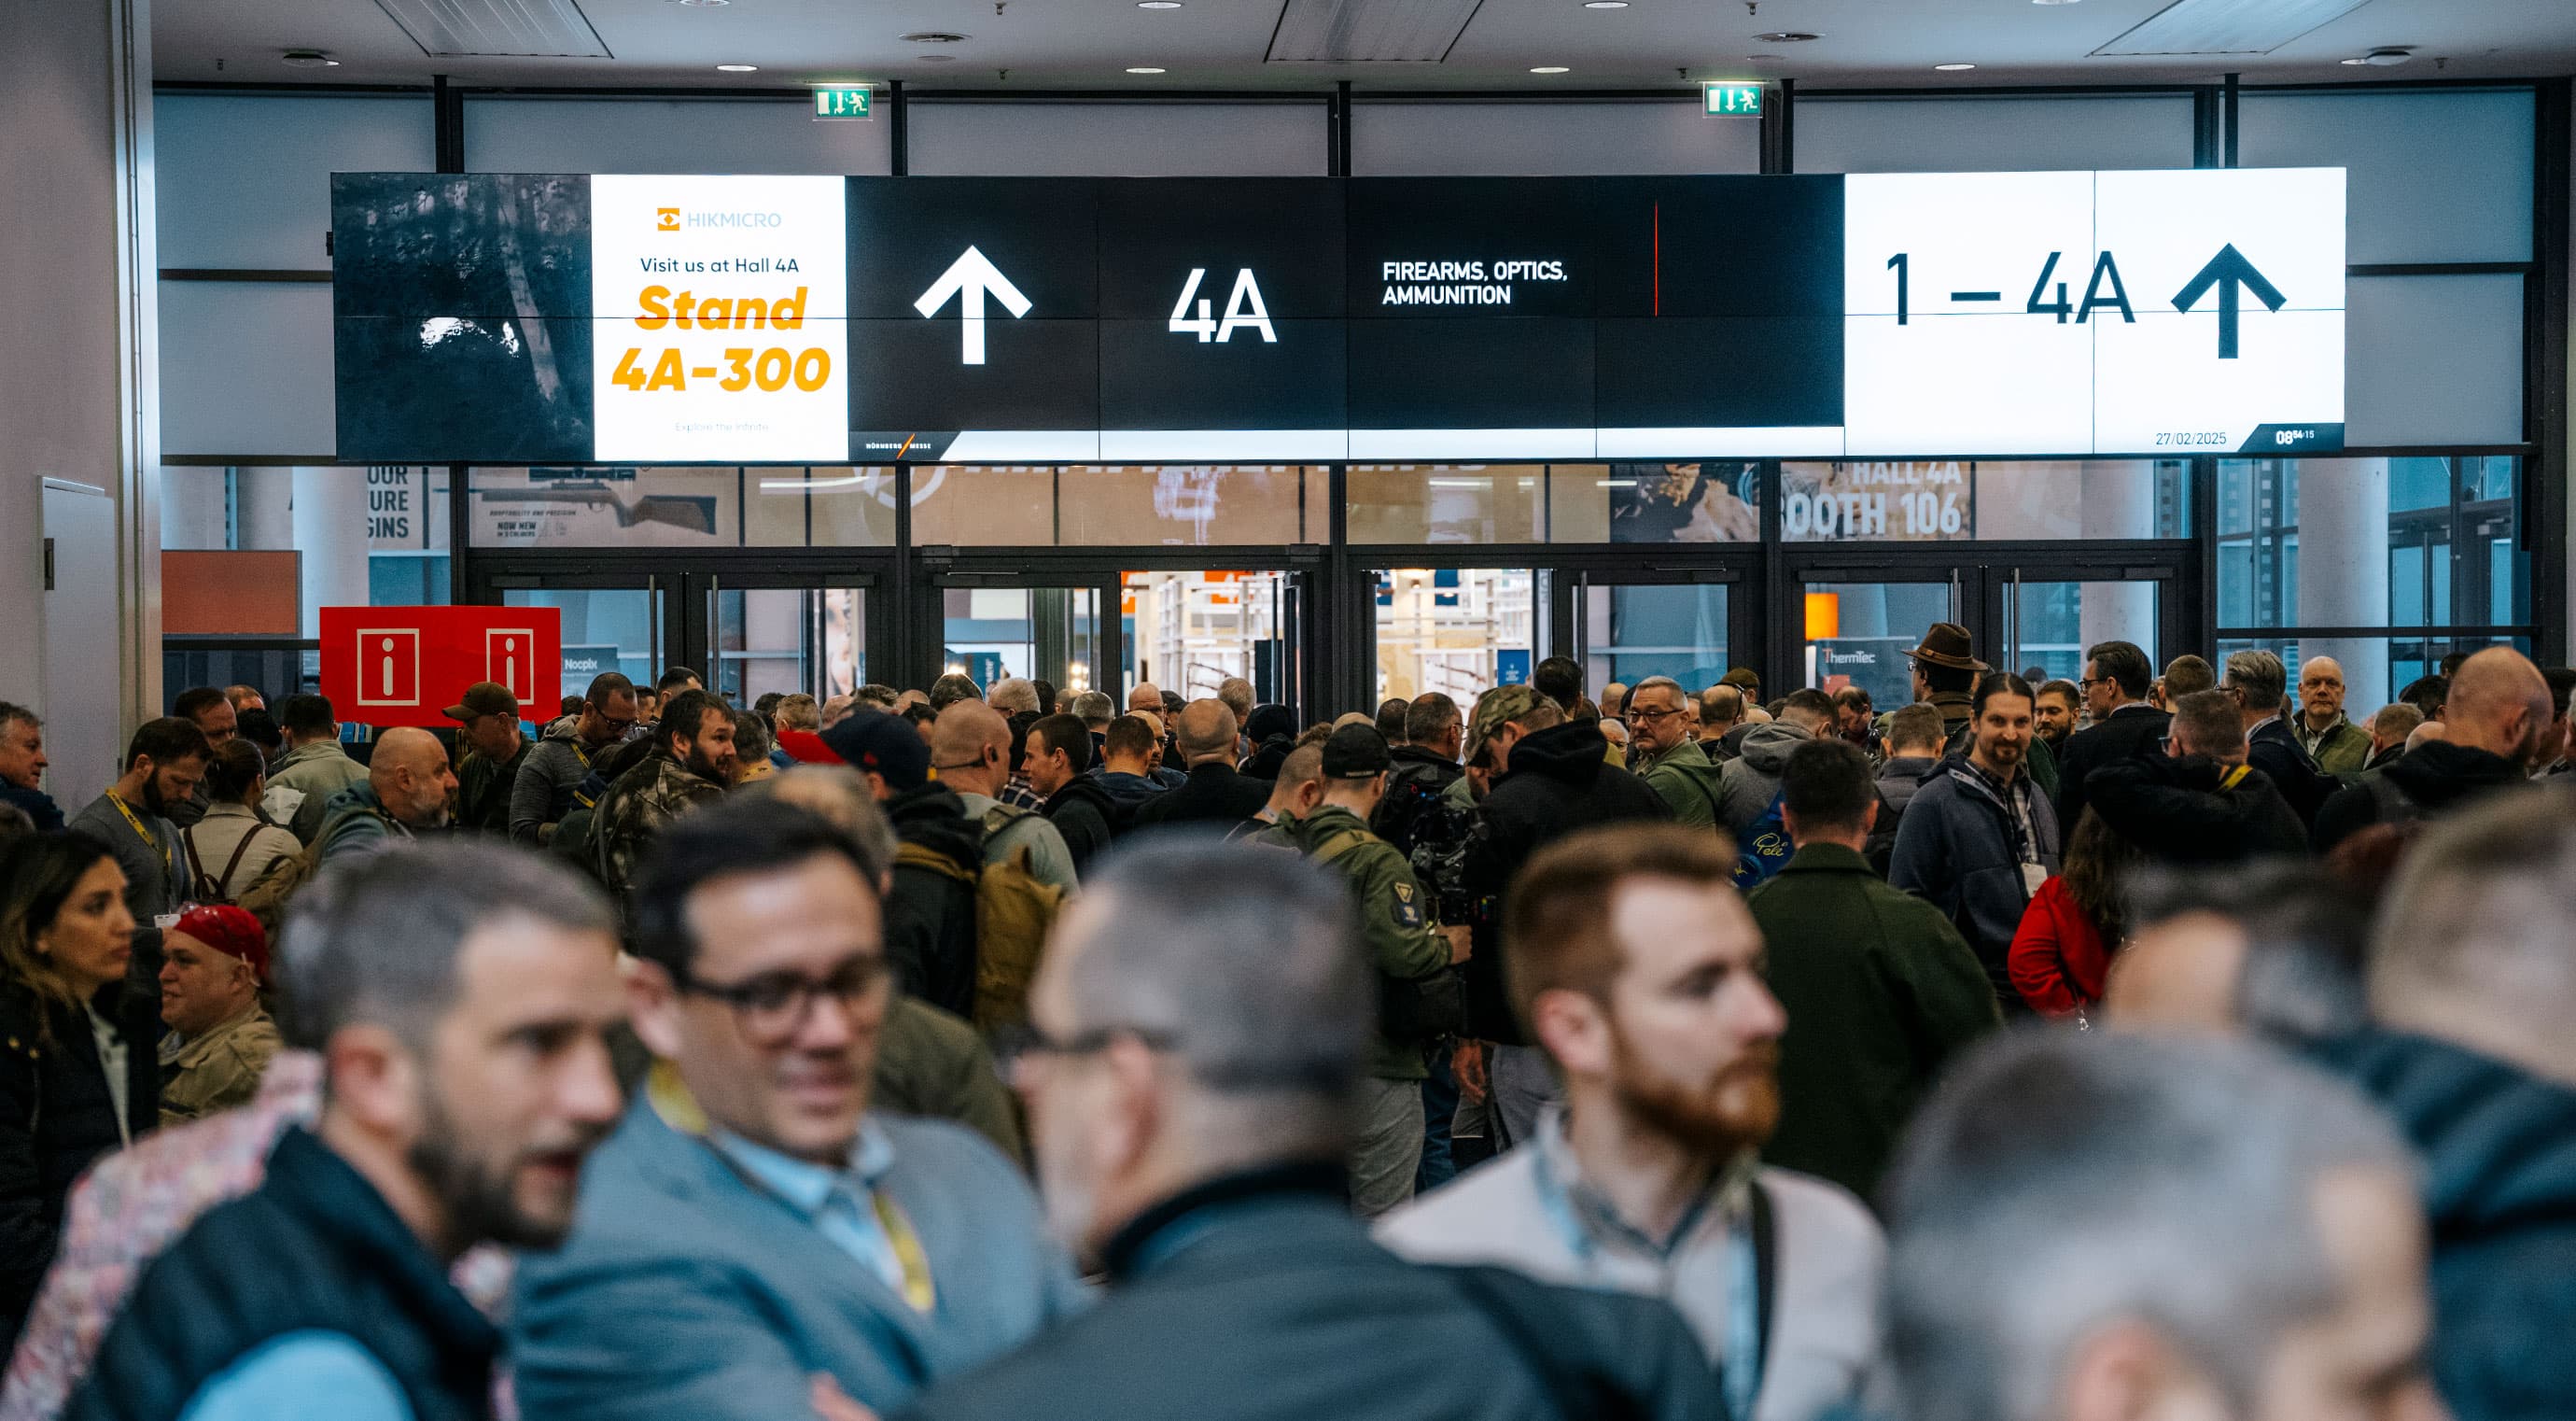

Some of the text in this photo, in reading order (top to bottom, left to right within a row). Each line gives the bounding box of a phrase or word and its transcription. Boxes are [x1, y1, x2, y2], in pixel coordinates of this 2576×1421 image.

[687, 212, 782, 228] HIKMICRO
[640, 258, 799, 273] Visit us at Hall 4A
[1382, 260, 1568, 283] FIREARMS, OPTICS,
[1382, 285, 1511, 304] AMMUNITION
[1887, 253, 1909, 325] 1
[2026, 251, 2135, 324] 4A
[634, 285, 808, 331] Stand
[1169, 268, 1277, 343] 4A
[611, 347, 831, 392] 4A-300
[2155, 432, 2227, 445] 27/02/2025
[1853, 462, 1962, 485] HALL 4A
[1781, 491, 1961, 535] OOTH 106
[497, 522, 516, 530] NOW
[565, 657, 597, 672] Nocpix
[1822, 648, 1876, 663] ThermTec
